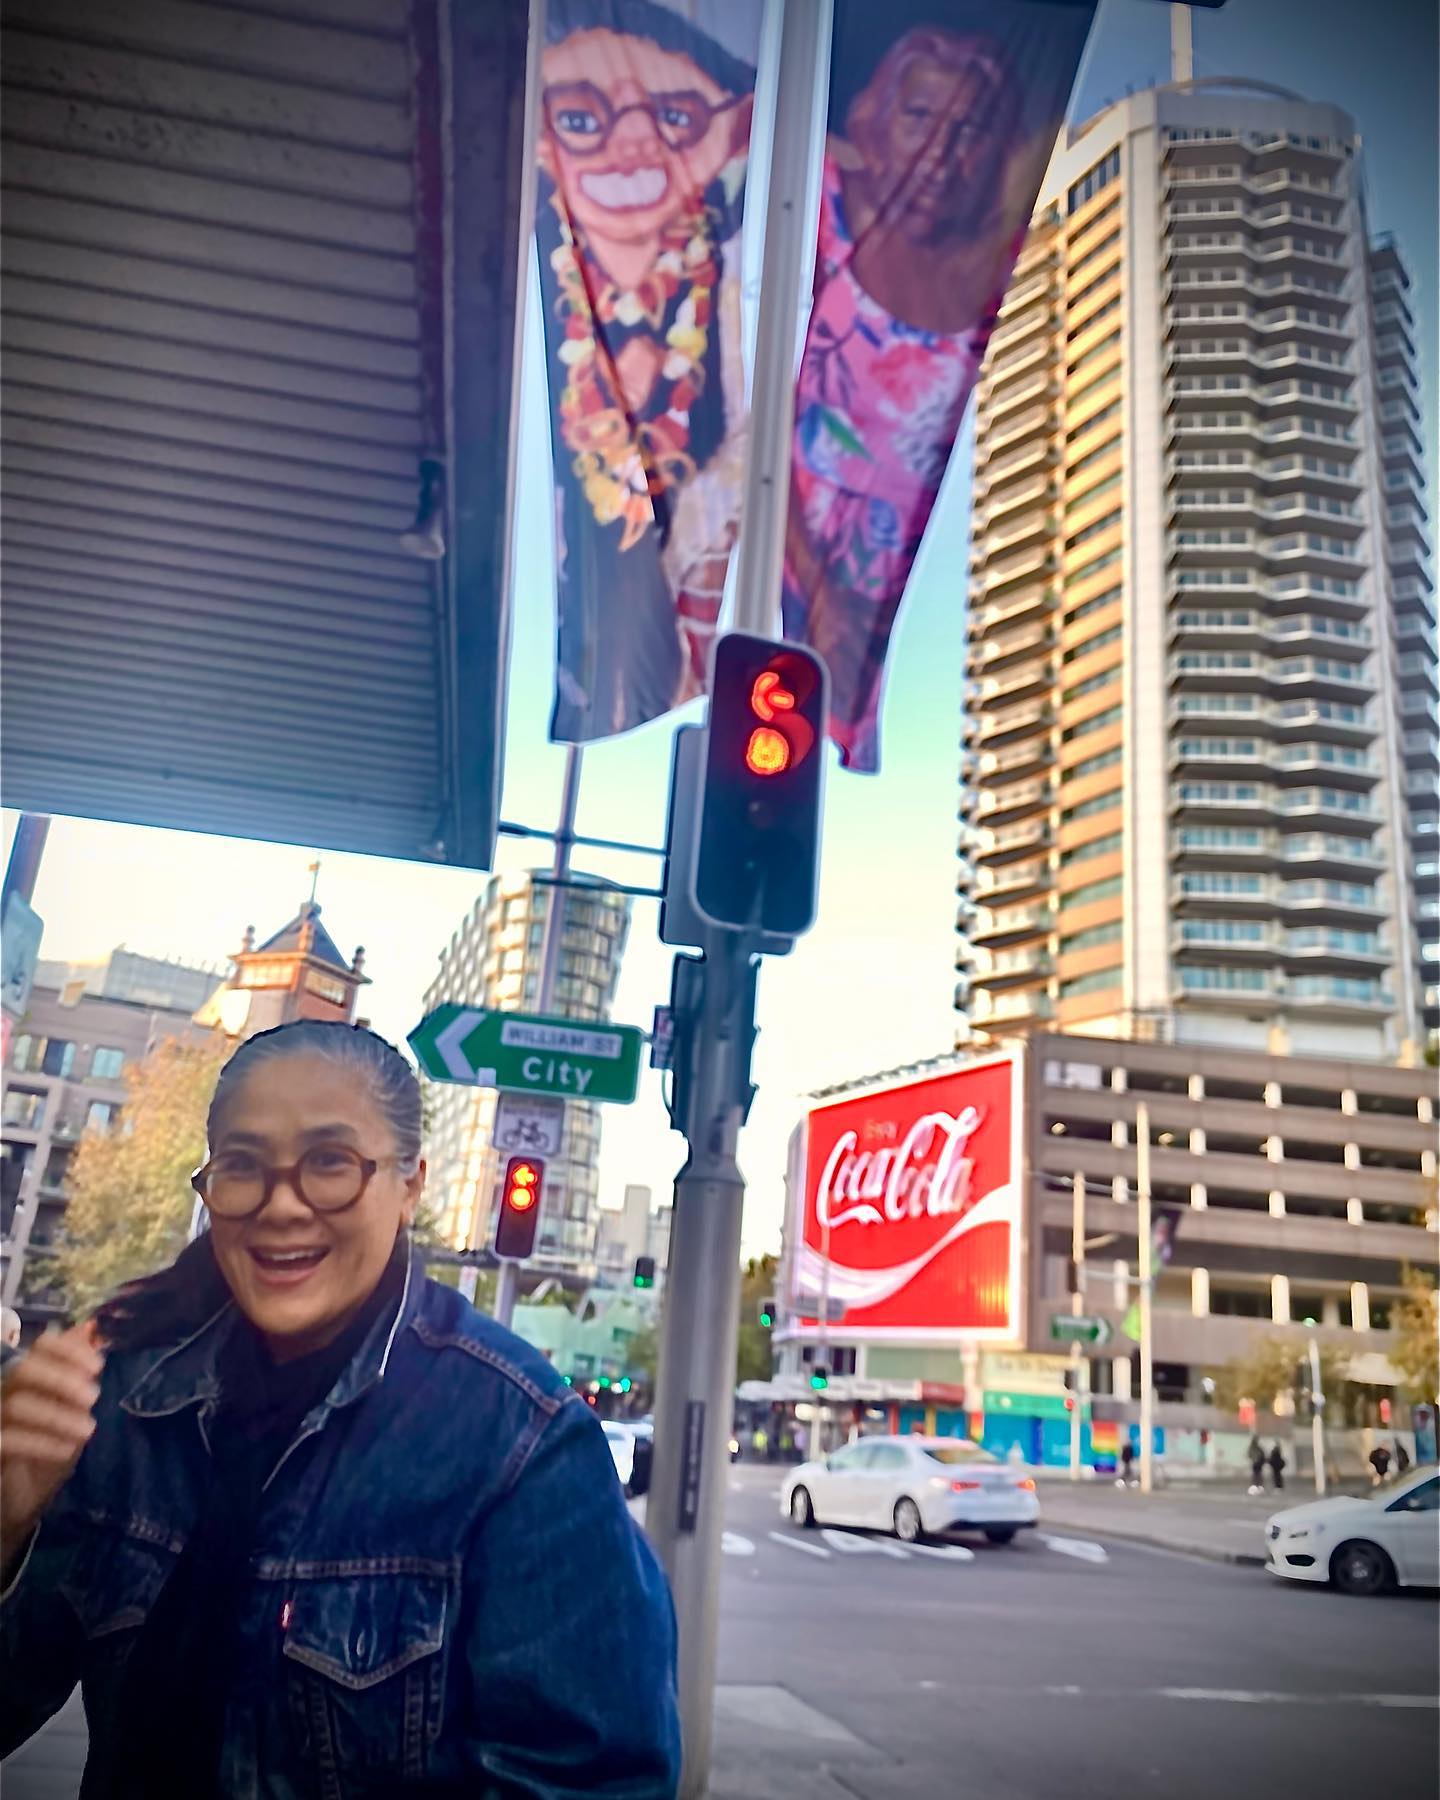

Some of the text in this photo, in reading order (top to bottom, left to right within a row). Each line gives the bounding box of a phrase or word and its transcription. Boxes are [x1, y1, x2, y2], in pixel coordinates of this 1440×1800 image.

[509, 1027, 615, 1052] WILLIAM ST
[522, 1056, 593, 1094] City
